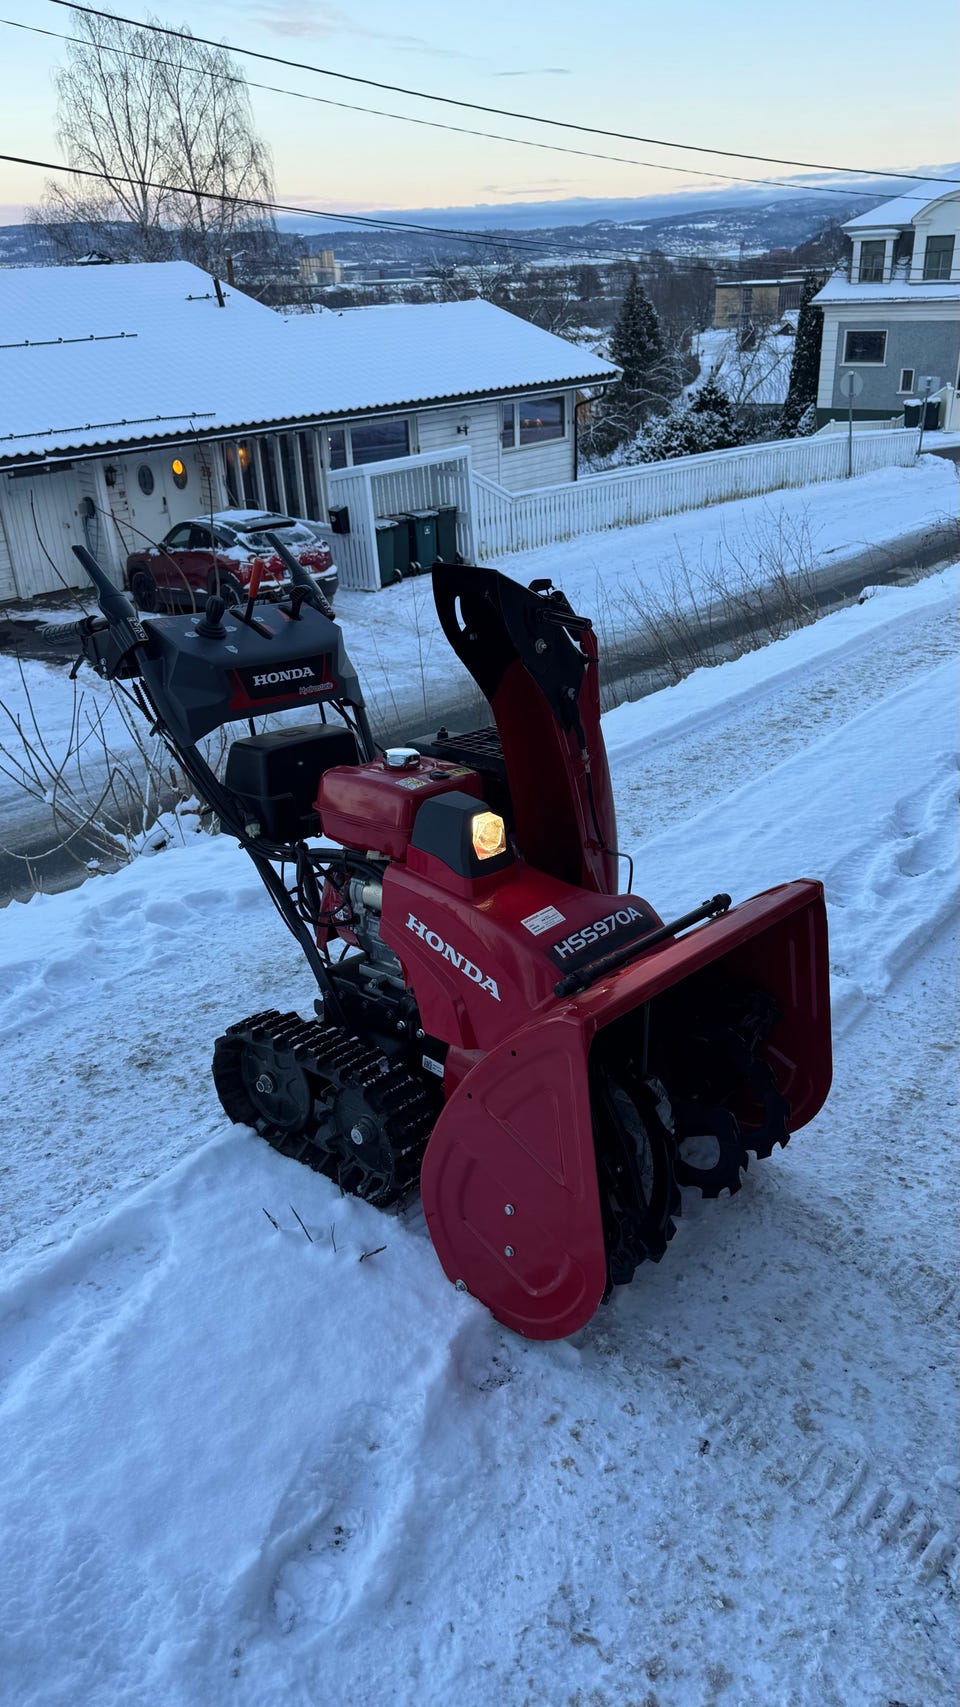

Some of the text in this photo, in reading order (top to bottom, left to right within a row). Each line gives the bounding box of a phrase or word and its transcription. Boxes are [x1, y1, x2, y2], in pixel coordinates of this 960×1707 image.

[252, 667, 315, 687] HONDA
[405, 912, 502, 1002] HONDA
[553, 907, 643, 959] HSS970A
